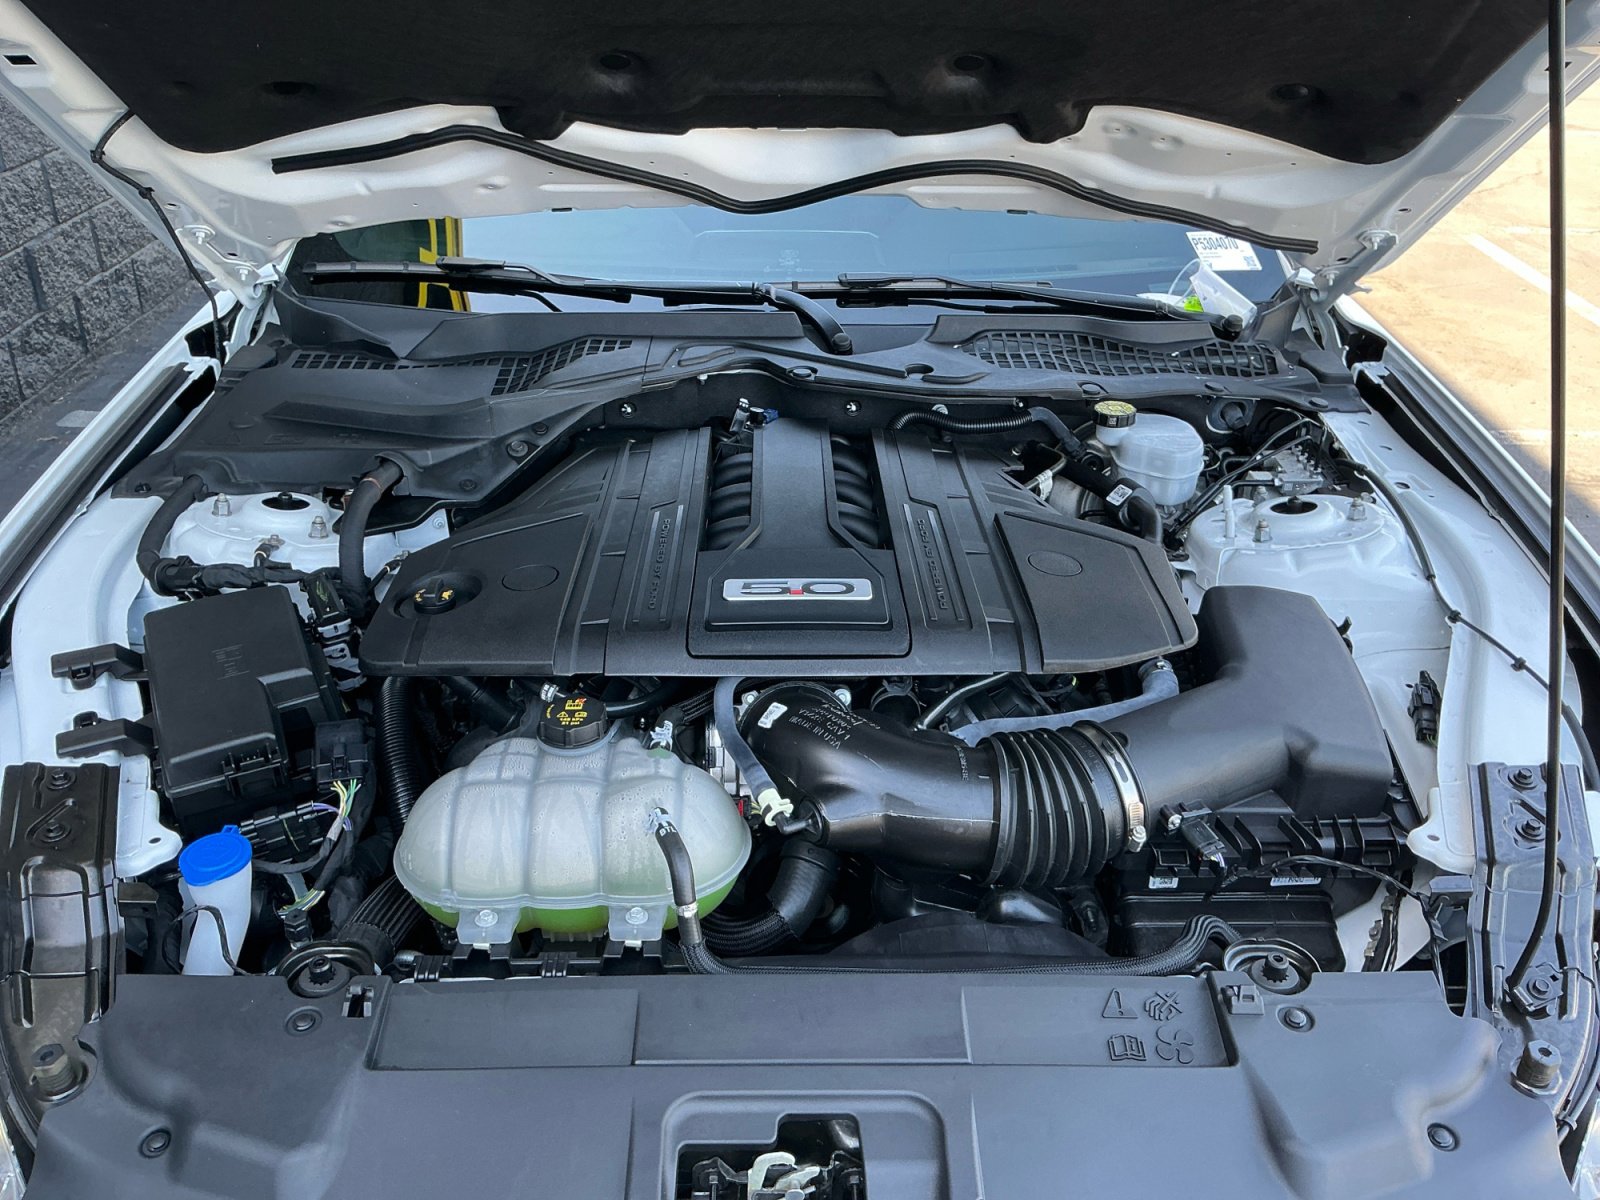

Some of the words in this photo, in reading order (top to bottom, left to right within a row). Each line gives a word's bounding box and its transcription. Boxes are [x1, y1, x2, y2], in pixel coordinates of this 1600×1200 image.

[1191, 236, 1239, 251] P5304070
[656, 518, 671, 563] POWERED
[916, 518, 929, 544] FORD
[653, 563, 663, 579] BY
[740, 581, 856, 595] 5.0
[928, 560, 949, 610] POWERED
